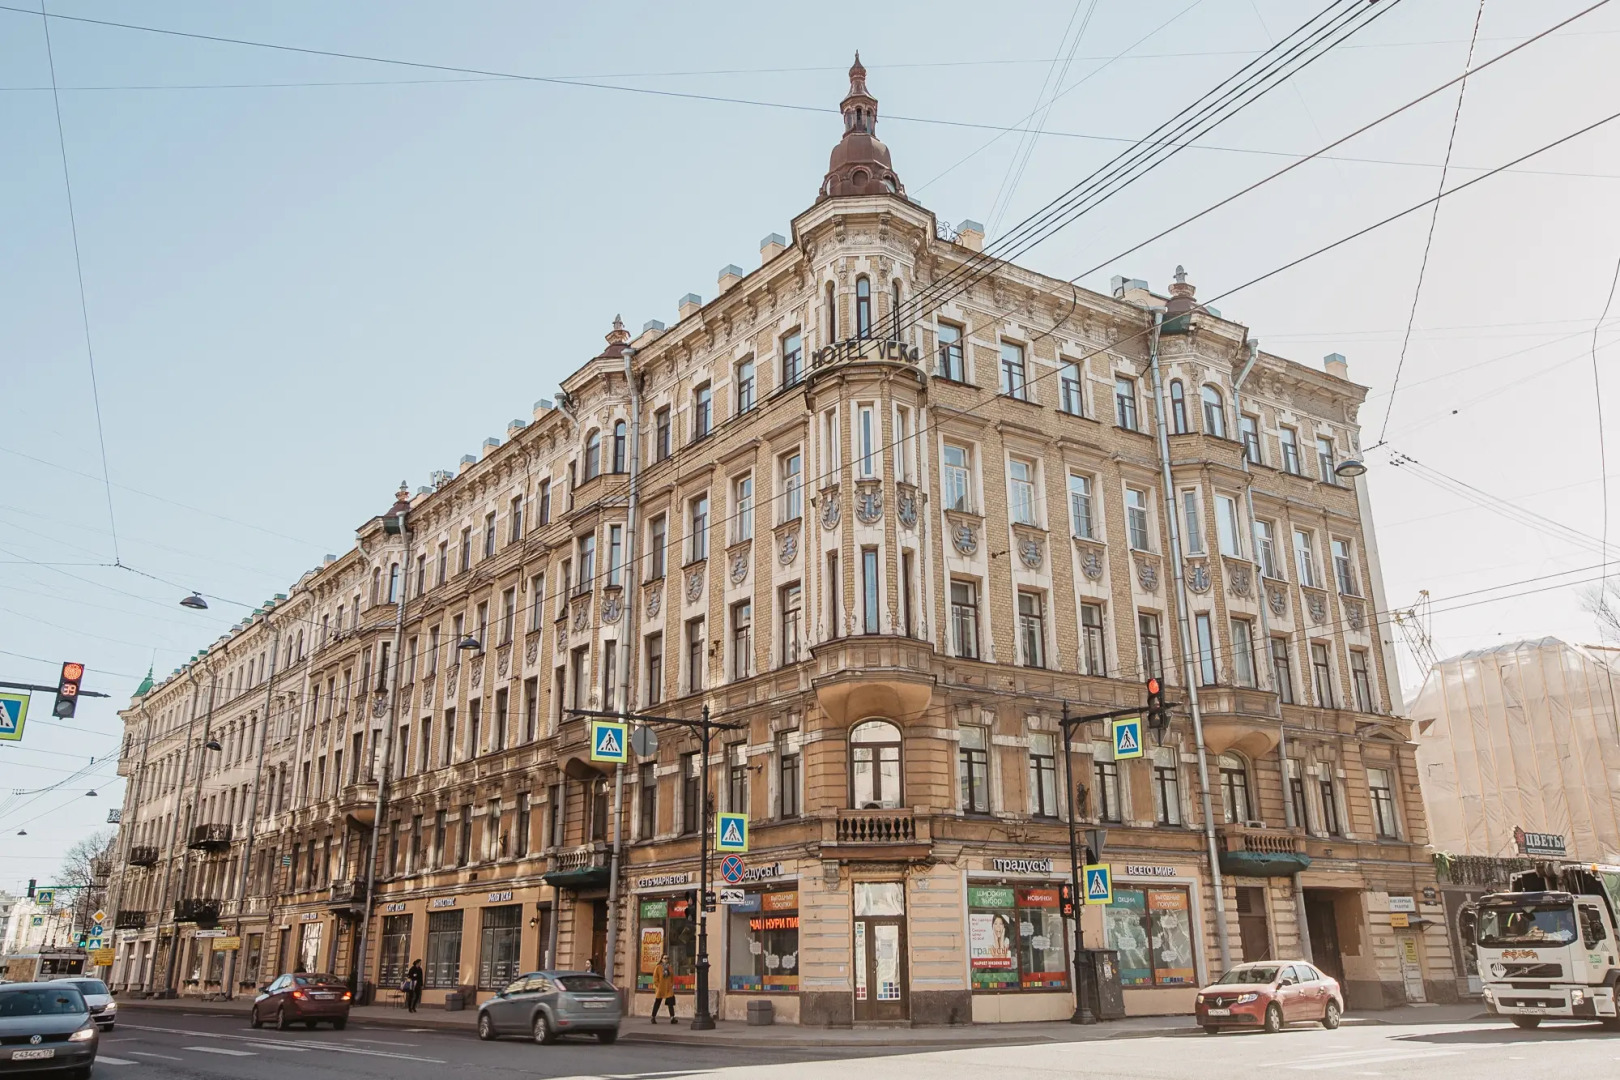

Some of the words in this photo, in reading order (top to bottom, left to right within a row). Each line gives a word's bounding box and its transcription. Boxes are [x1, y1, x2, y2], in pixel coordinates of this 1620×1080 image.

[812, 340, 868, 370] HOTEL
[63, 684, 77, 696] 39
[1525, 833, 1565, 848] ЦВЕТЫ
[994, 858, 1053, 873] градусы
[1127, 865, 1153, 875] ВСЕГО
[1154, 866, 1177, 876] МИРА
[638, 877, 653, 888] СЕТЬ
